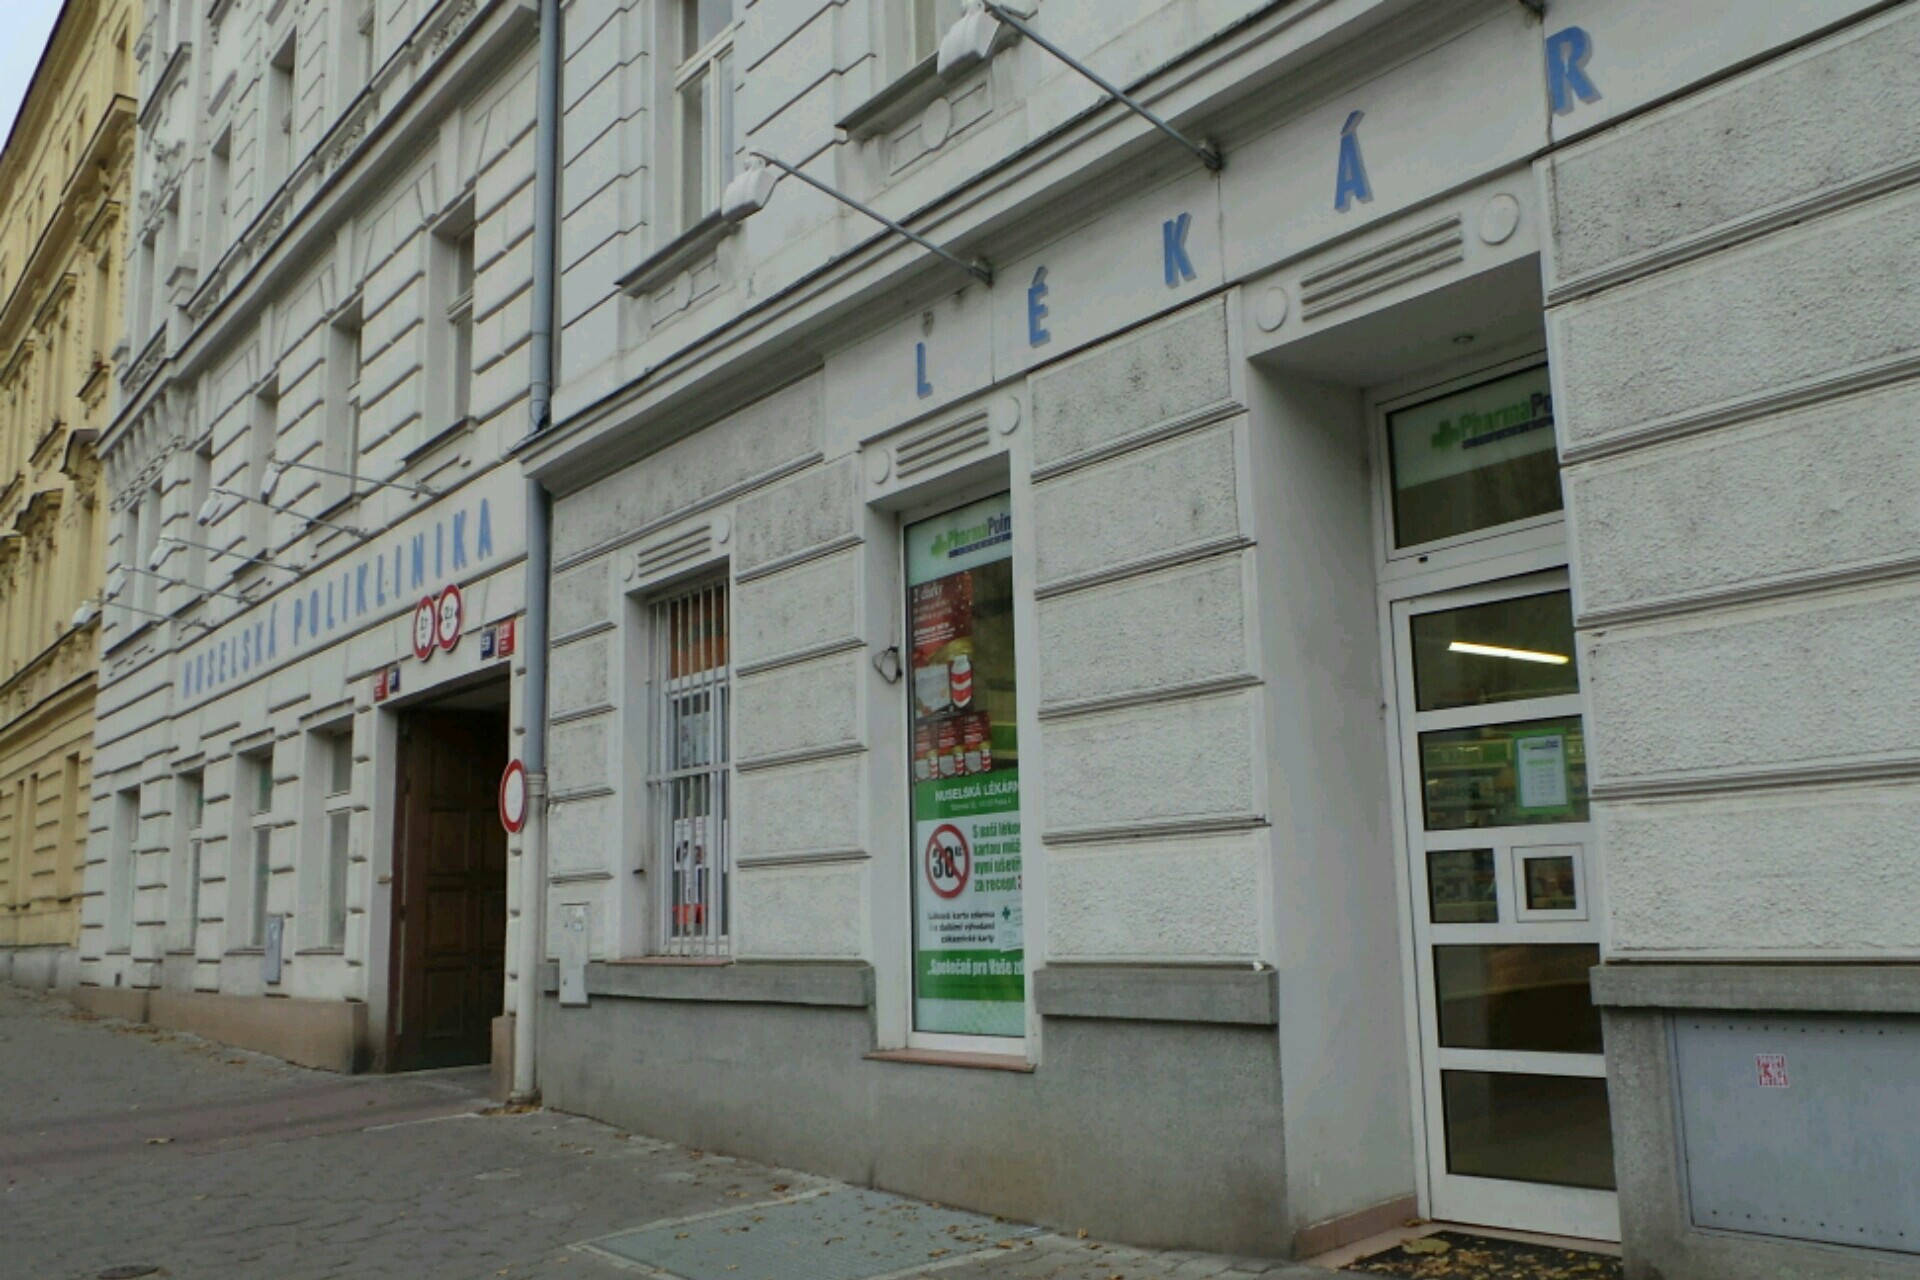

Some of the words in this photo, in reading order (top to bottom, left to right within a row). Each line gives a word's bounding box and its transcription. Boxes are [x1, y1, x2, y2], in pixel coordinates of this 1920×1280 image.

[183, 601, 277, 699] NUSELSKÁ
[294, 497, 494, 647] POLIKLINIKA
[934, 783, 982, 802] NUSELSKÁ
[972, 823, 978, 839] S
[933, 846, 954, 879] 30
[974, 879, 984, 893] za
[985, 876, 1016, 893] recept
[972, 961, 988, 977] pro
